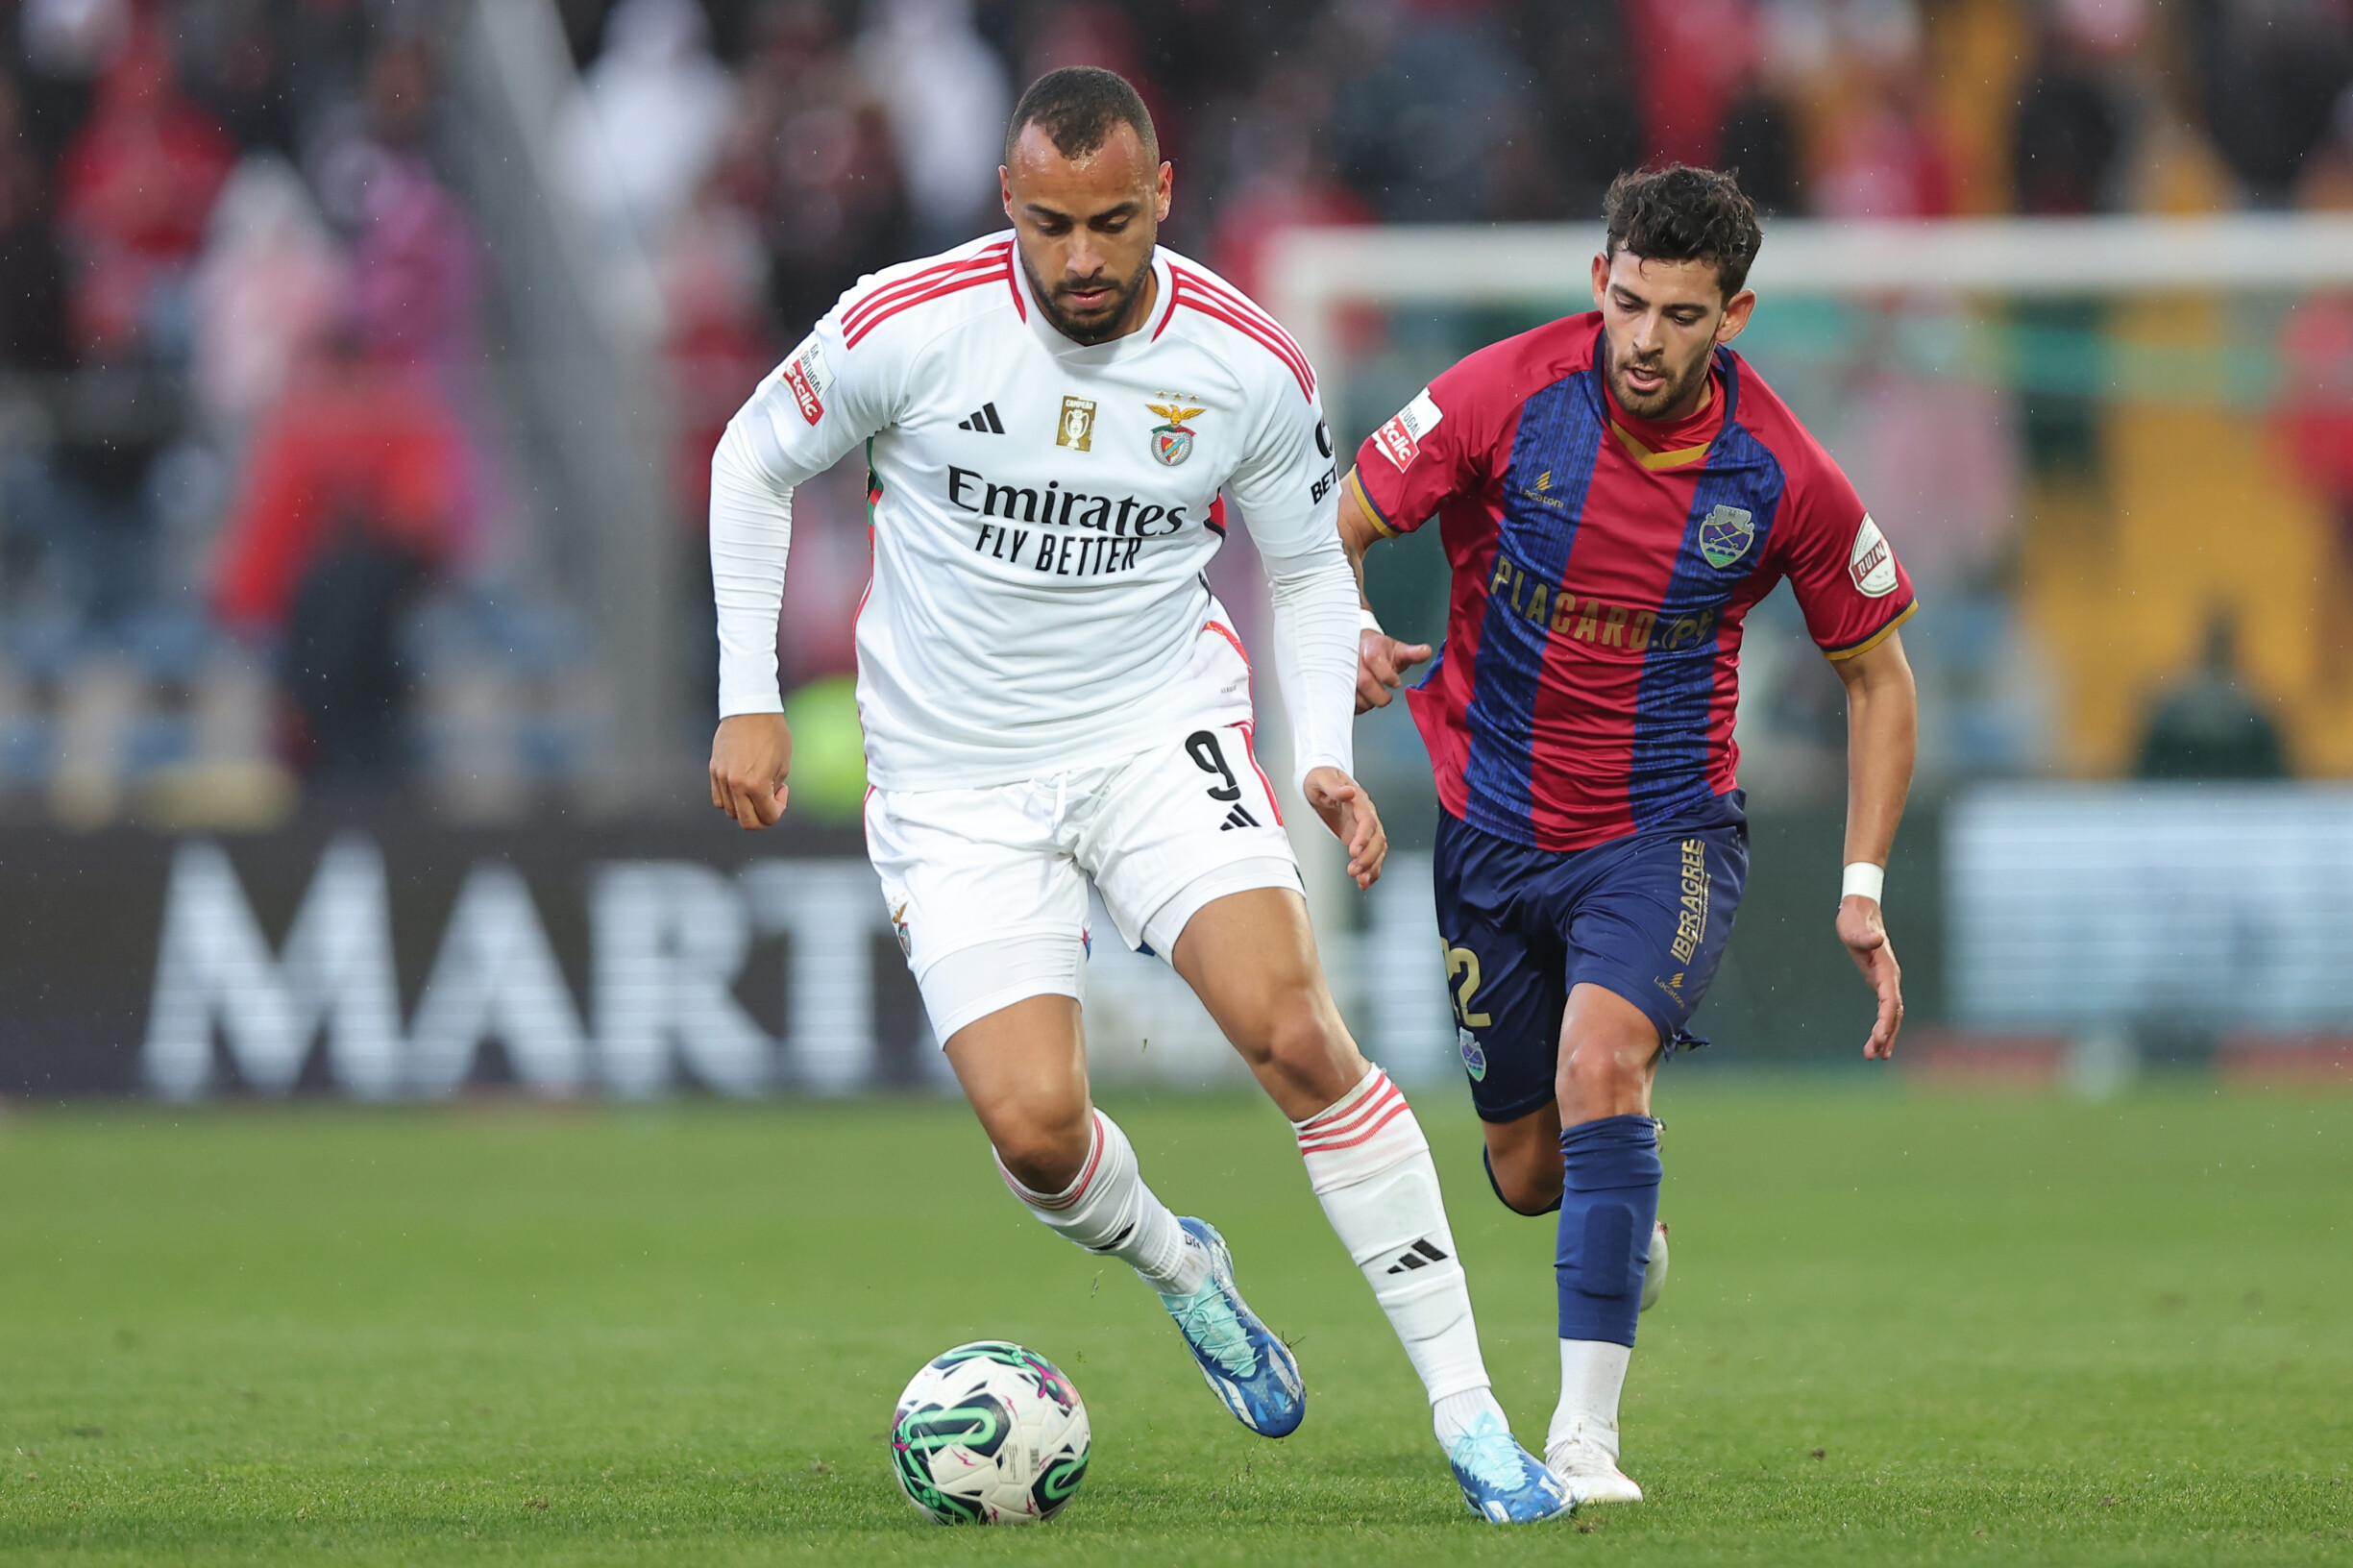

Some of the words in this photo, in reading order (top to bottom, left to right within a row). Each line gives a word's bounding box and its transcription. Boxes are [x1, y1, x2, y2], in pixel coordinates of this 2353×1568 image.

[1065, 398, 1094, 410] CAMPEÃO
[947, 464, 1188, 537] Emirates
[1518, 484, 1564, 509] Lacatoni
[974, 523, 1029, 564] FLY
[1034, 533, 1142, 576] BETTER
[1185, 730, 1241, 801] 9
[1670, 839, 1704, 966] IBERAGREE
[142, 832, 927, 1103] MART
